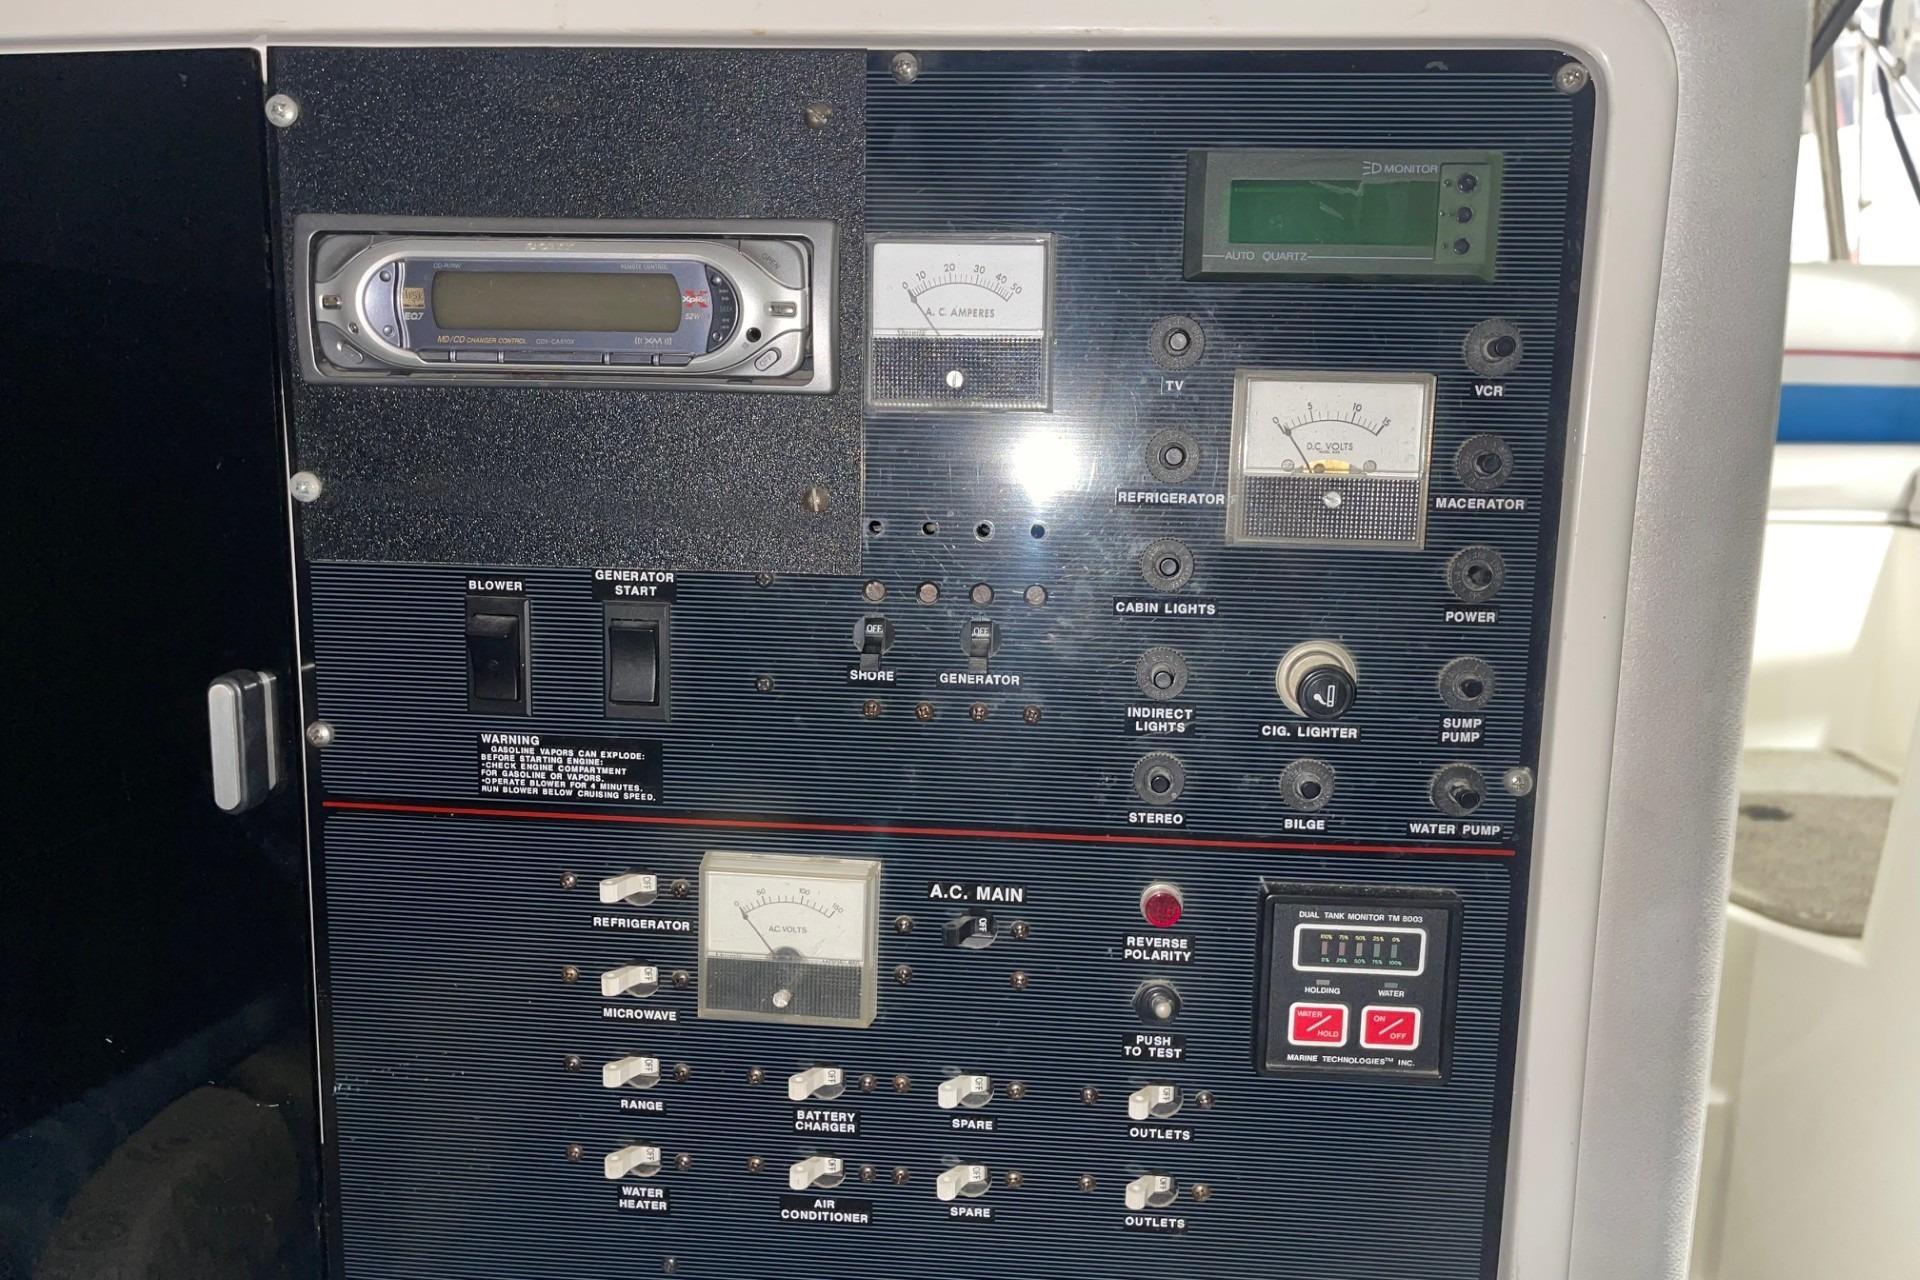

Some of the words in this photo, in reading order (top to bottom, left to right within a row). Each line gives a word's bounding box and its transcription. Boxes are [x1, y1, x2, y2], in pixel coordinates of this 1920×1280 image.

[1382, 164, 1439, 174] MONITOR
[1224, 251, 1255, 261] AUTO
[1262, 251, 1308, 262] QUARTZ
[943, 263, 956, 273] 20
[973, 264, 986, 274] 30
[916, 270, 927, 280] 10
[995, 273, 1008, 284] 40
[902, 282, 908, 290] 0
[1010, 282, 1022, 294] 50
[404, 312, 424, 320] EQ7
[950, 307, 995, 318] AMPERES
[437, 335, 465, 344] MD/CD
[1166, 380, 1184, 391] TV
[1475, 385, 1504, 397] VCR
[1352, 402, 1362, 412] 10
[1272, 416, 1280, 425] 0
[1382, 416, 1391, 427] 15
[1325, 442, 1353, 451] VOLTS
[1118, 491, 1225, 505] REFRIGERATOR
[1435, 497, 1525, 510] MACERATOR
[595, 569, 675, 583] GENERATOR
[468, 580, 523, 591] BLOWER
[615, 585, 657, 597] START
[1115, 601, 1159, 614] CABIN
[1164, 603, 1216, 615] LIGHTS
[1445, 611, 1496, 623] POWER
[866, 623, 883, 633] OFF
[973, 627, 989, 637] OFF
[850, 670, 895, 682] SHORE
[939, 673, 1020, 686] GENERATOR
[1127, 707, 1193, 720] INDIRECT
[1135, 721, 1186, 733] LIGHTS
[1443, 718, 1483, 729] SUMP
[1261, 725, 1291, 737] CIG.
[1297, 727, 1358, 739] LIGHTER
[1441, 731, 1480, 743] PUMP
[481, 733, 540, 746] WARNING
[491, 745, 535, 755] GASOLINE
[540, 748, 574, 757] VAPORS
[578, 750, 597, 758] CAN
[600, 751, 645, 760] EXPLODE:
[481, 753, 515, 762] BEFORE
[519, 755, 563, 764] STARTING
[566, 757, 603, 766] ENGINE:
[520, 763, 553, 772] ENGINE
[557, 765, 627, 775] COMPARTMENT
[481, 769, 498, 777] FOR
[502, 770, 546, 779] GASOLINE
[550, 772, 563, 780] OR
[566, 773, 605, 782] VAPORS.
[529, 780, 566, 788] BLOWER
[570, 781, 587, 789] FOR
[600, 783, 644, 792] MINUTES.
[481, 785, 499, 793] RUN
[502, 786, 539, 795] BLOWER
[542, 787, 573, 797] BELOW
[577, 789, 619, 799] CRUISING
[623, 792, 656, 802] SPEED.
[1128, 812, 1184, 825] STEREO
[1284, 819, 1325, 831] BILGE
[1409, 822, 1456, 835] WATER
[1462, 824, 1501, 836] PUMP
[756, 887, 766, 896] 50
[929, 884, 968, 900] A.C.
[976, 886, 1023, 902] MAIN
[1299, 910, 1320, 919] DUAL
[1324, 911, 1345, 920] TANK
[1347, 913, 1385, 922] MONITOR
[1388, 914, 1400, 922] TM
[593, 916, 690, 931] REFRIGERATOR
[783, 926, 808, 934] VOLTS
[1127, 936, 1188, 949] REVERSE
[1124, 949, 1192, 962] POLARITY
[1304, 986, 1341, 995] HOLDING
[1377, 989, 1405, 998] WATER
[603, 1007, 677, 1021] MICROWAVE
[1297, 1010, 1323, 1018] WATER
[1317, 1029, 1339, 1038] HOLD
[1389, 1032, 1407, 1040] OFF
[1136, 1034, 1171, 1046] PUSH
[1124, 1046, 1142, 1057] TO
[1148, 1047, 1182, 1059] TEST
[1286, 1053, 1318, 1062] MARINE
[1397, 1059, 1416, 1067] INC.
[620, 1099, 663, 1111] RANGE
[796, 1110, 855, 1122] BATTERY
[795, 1121, 856, 1133] CHARGER
[952, 1118, 993, 1130] SPARE
[1129, 1127, 1191, 1141] OUTLETS
[622, 1186, 664, 1199] WATER
[618, 1198, 667, 1211] HEATER
[813, 1199, 835, 1210] AIR
[780, 1209, 869, 1224] CONDITIONER
[950, 1206, 991, 1218] SPARE
[1124, 1216, 1186, 1229] OUTLETS
